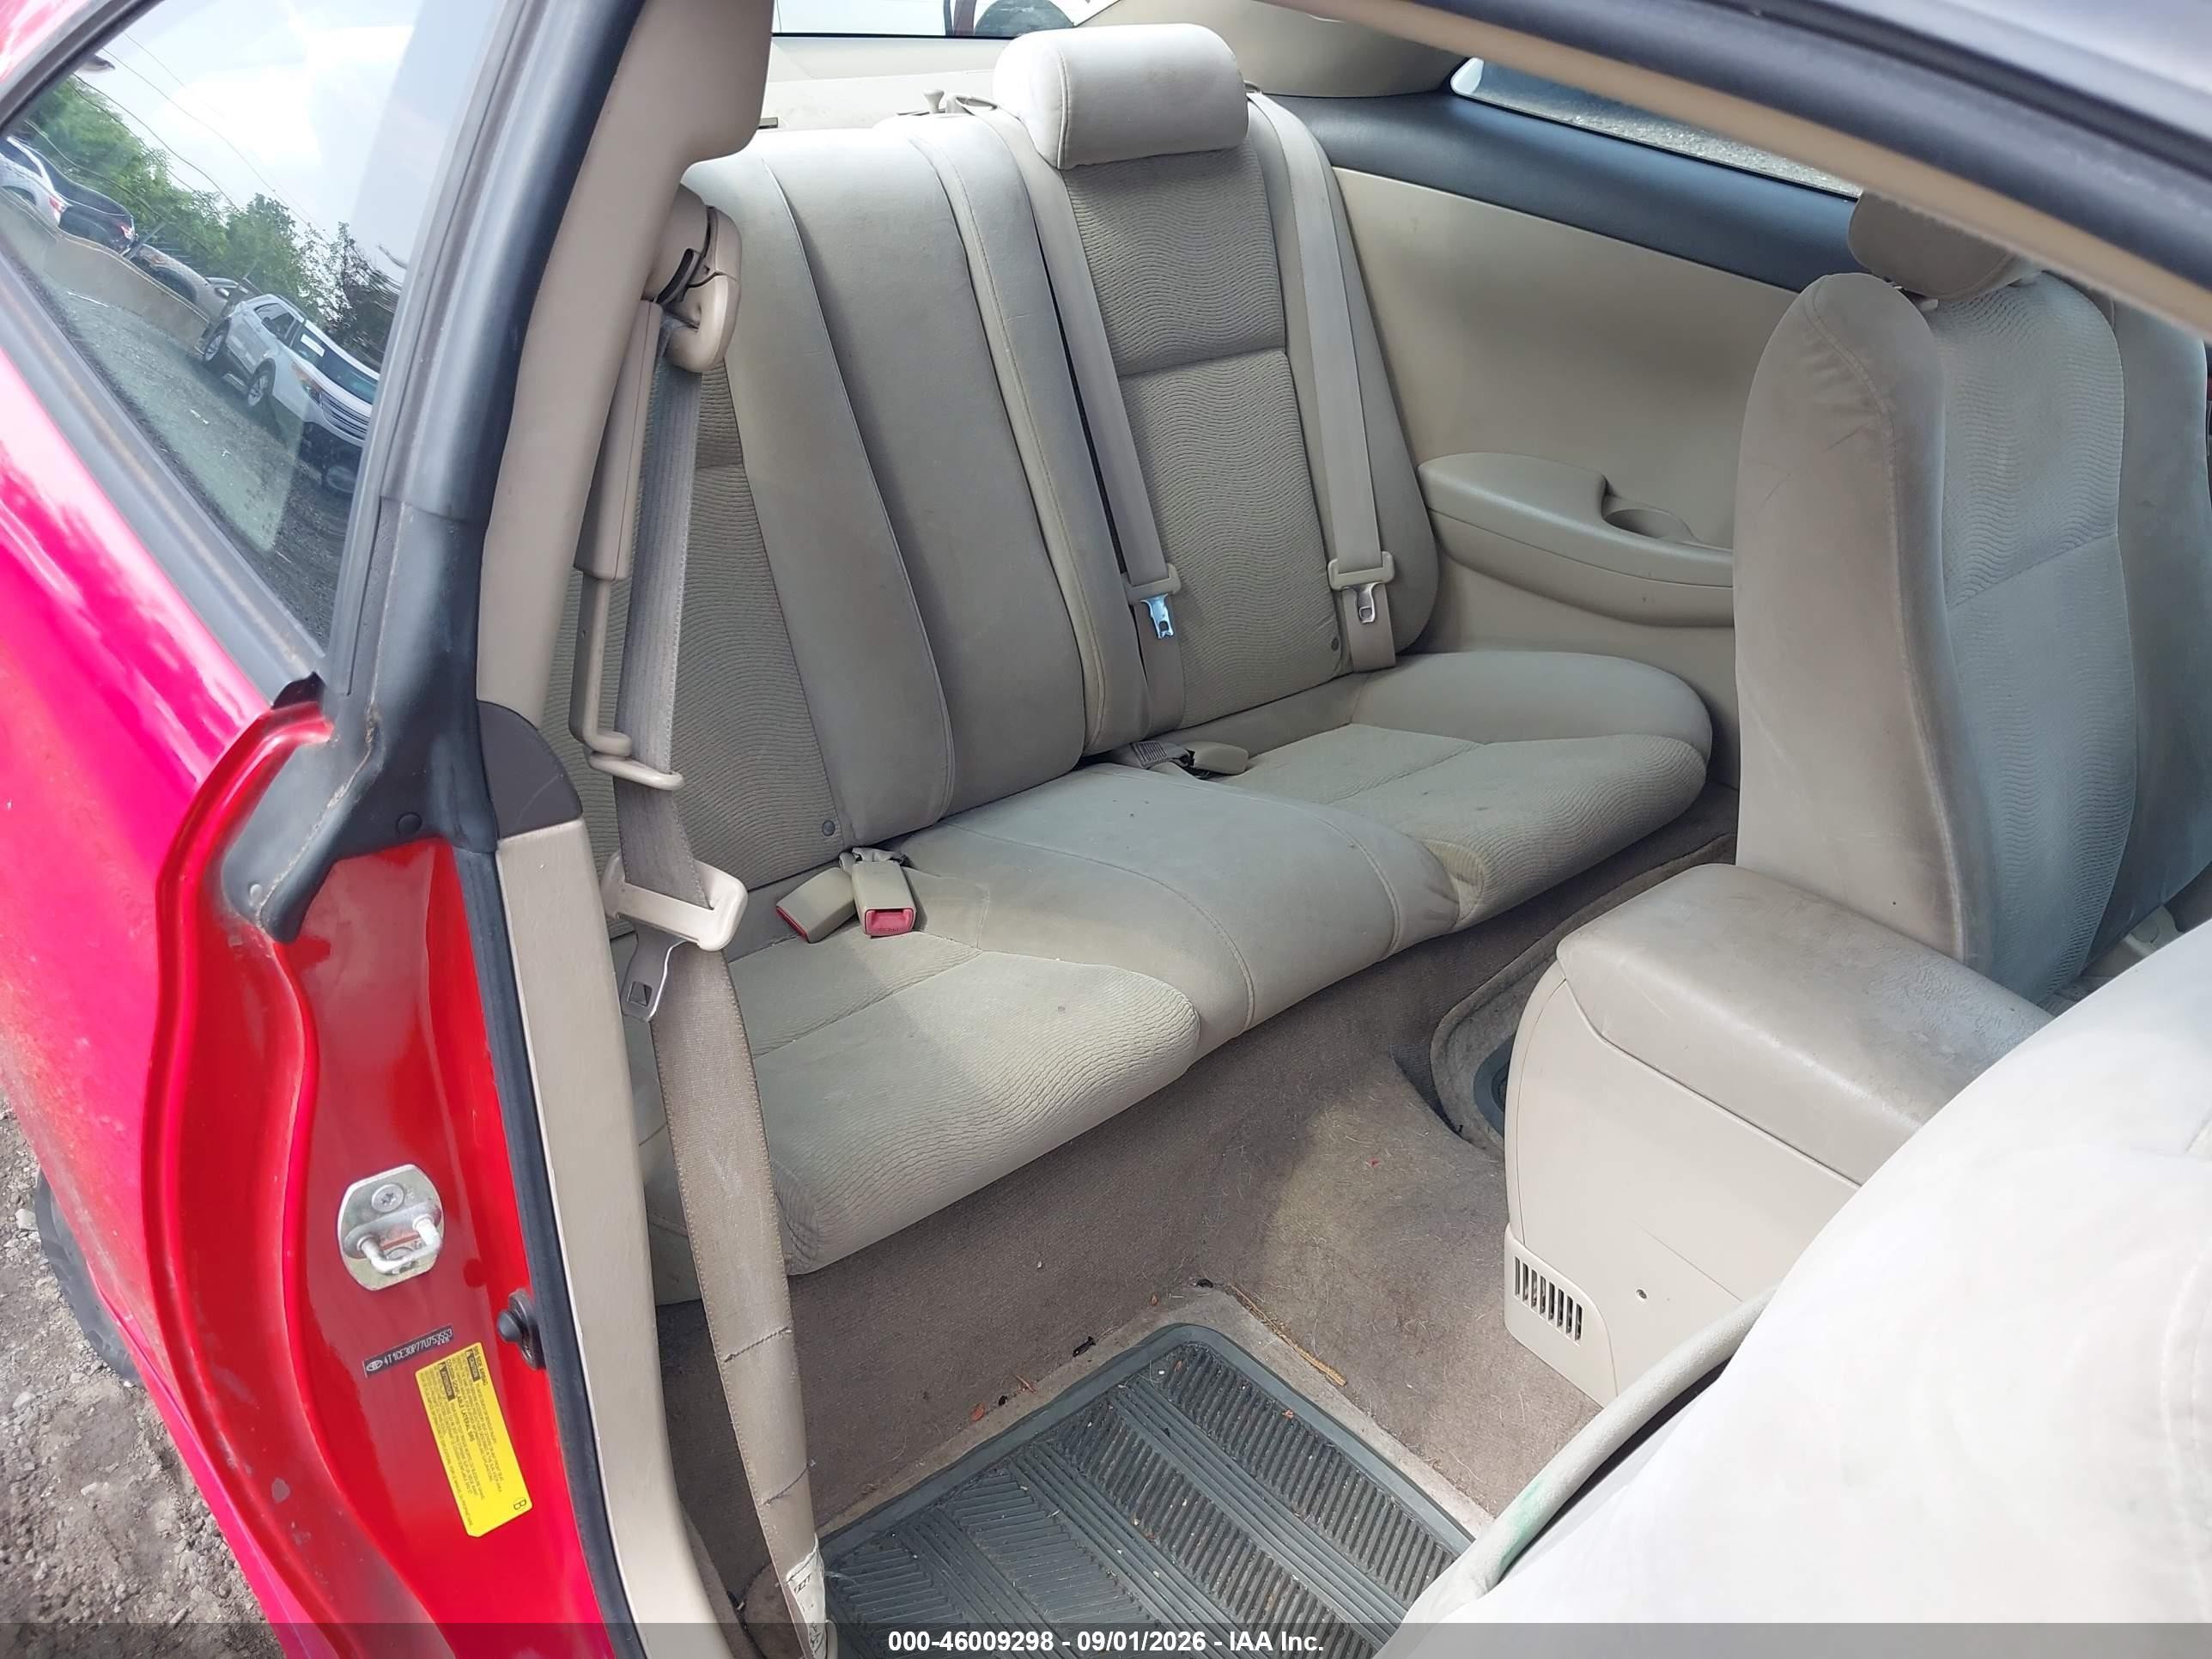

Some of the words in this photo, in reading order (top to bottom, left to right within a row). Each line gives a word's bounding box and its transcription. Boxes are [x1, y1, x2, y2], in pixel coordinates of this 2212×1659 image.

[467, 1356, 479, 1378] CAUTION
[440, 1369, 454, 1397] ATTENTION
[513, 1498, 527, 1510] B
